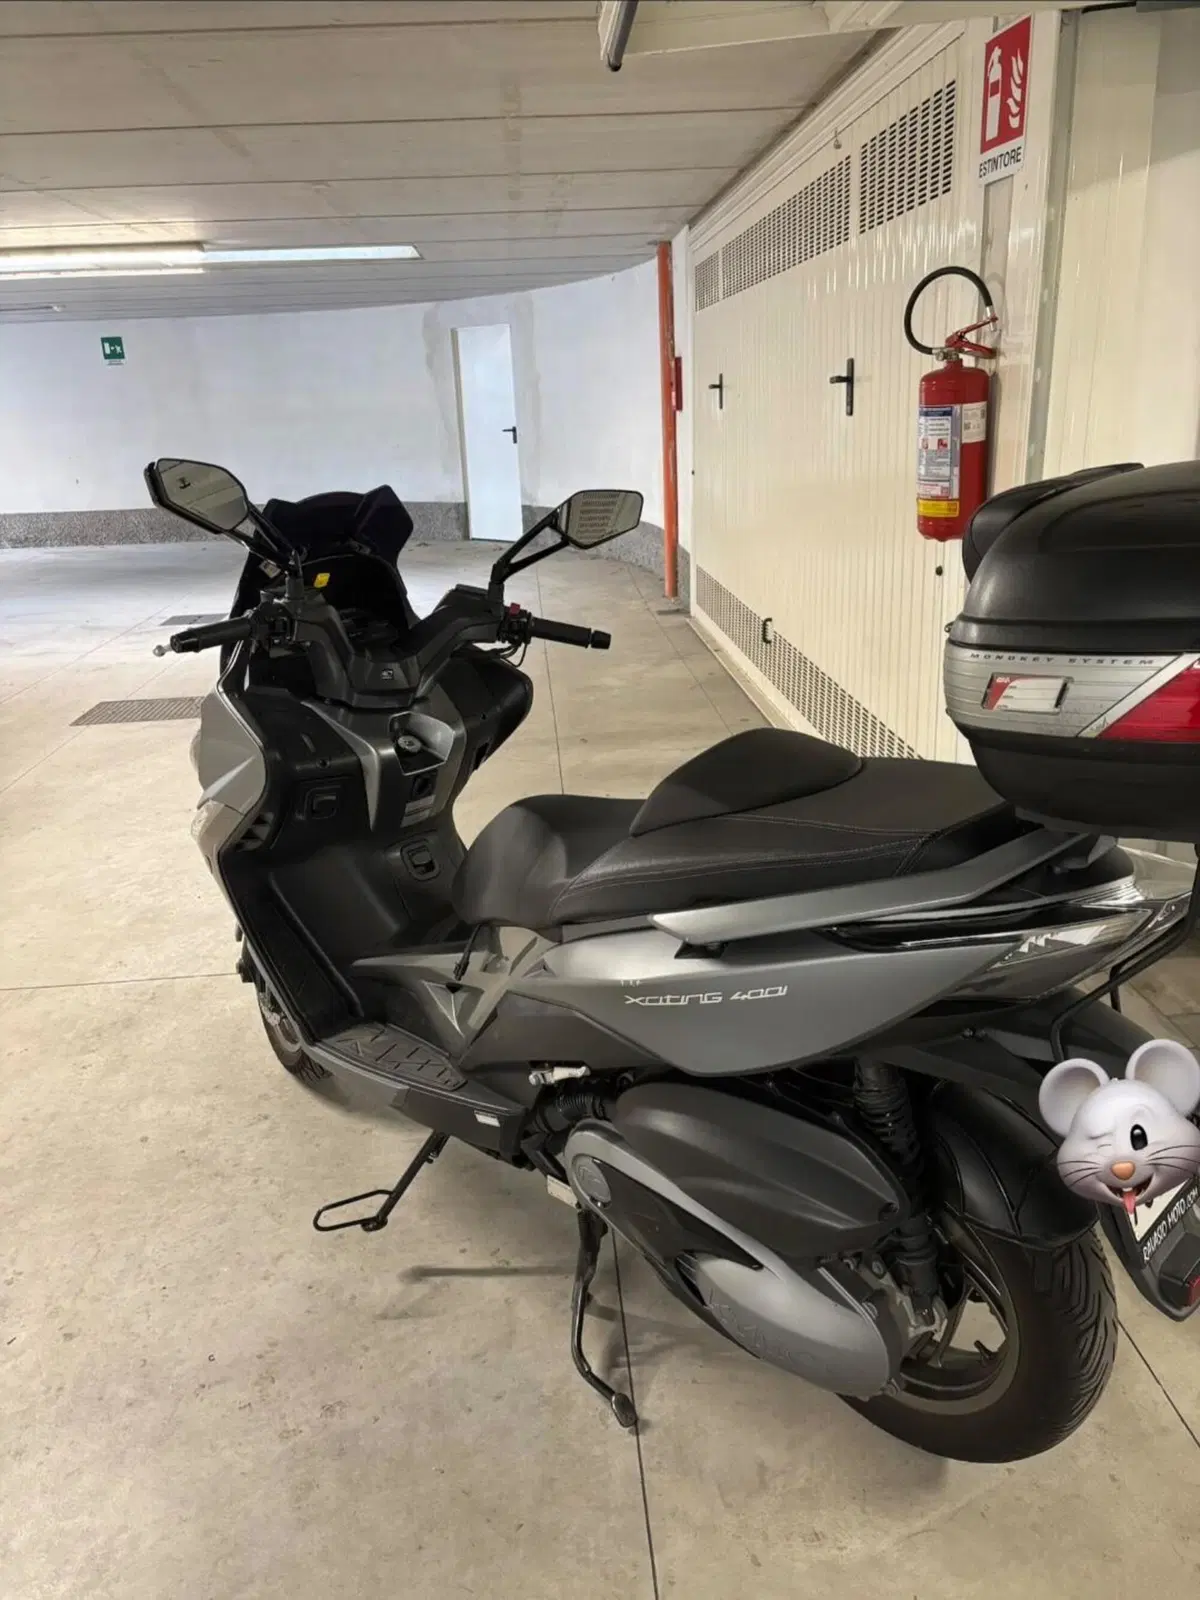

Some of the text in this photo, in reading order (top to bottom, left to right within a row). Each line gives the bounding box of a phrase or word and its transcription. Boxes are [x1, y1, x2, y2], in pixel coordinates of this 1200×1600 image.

[979, 146, 1022, 178] ESTINTORE
[970, 653, 1155, 666] MONOKEY SYSTEM
